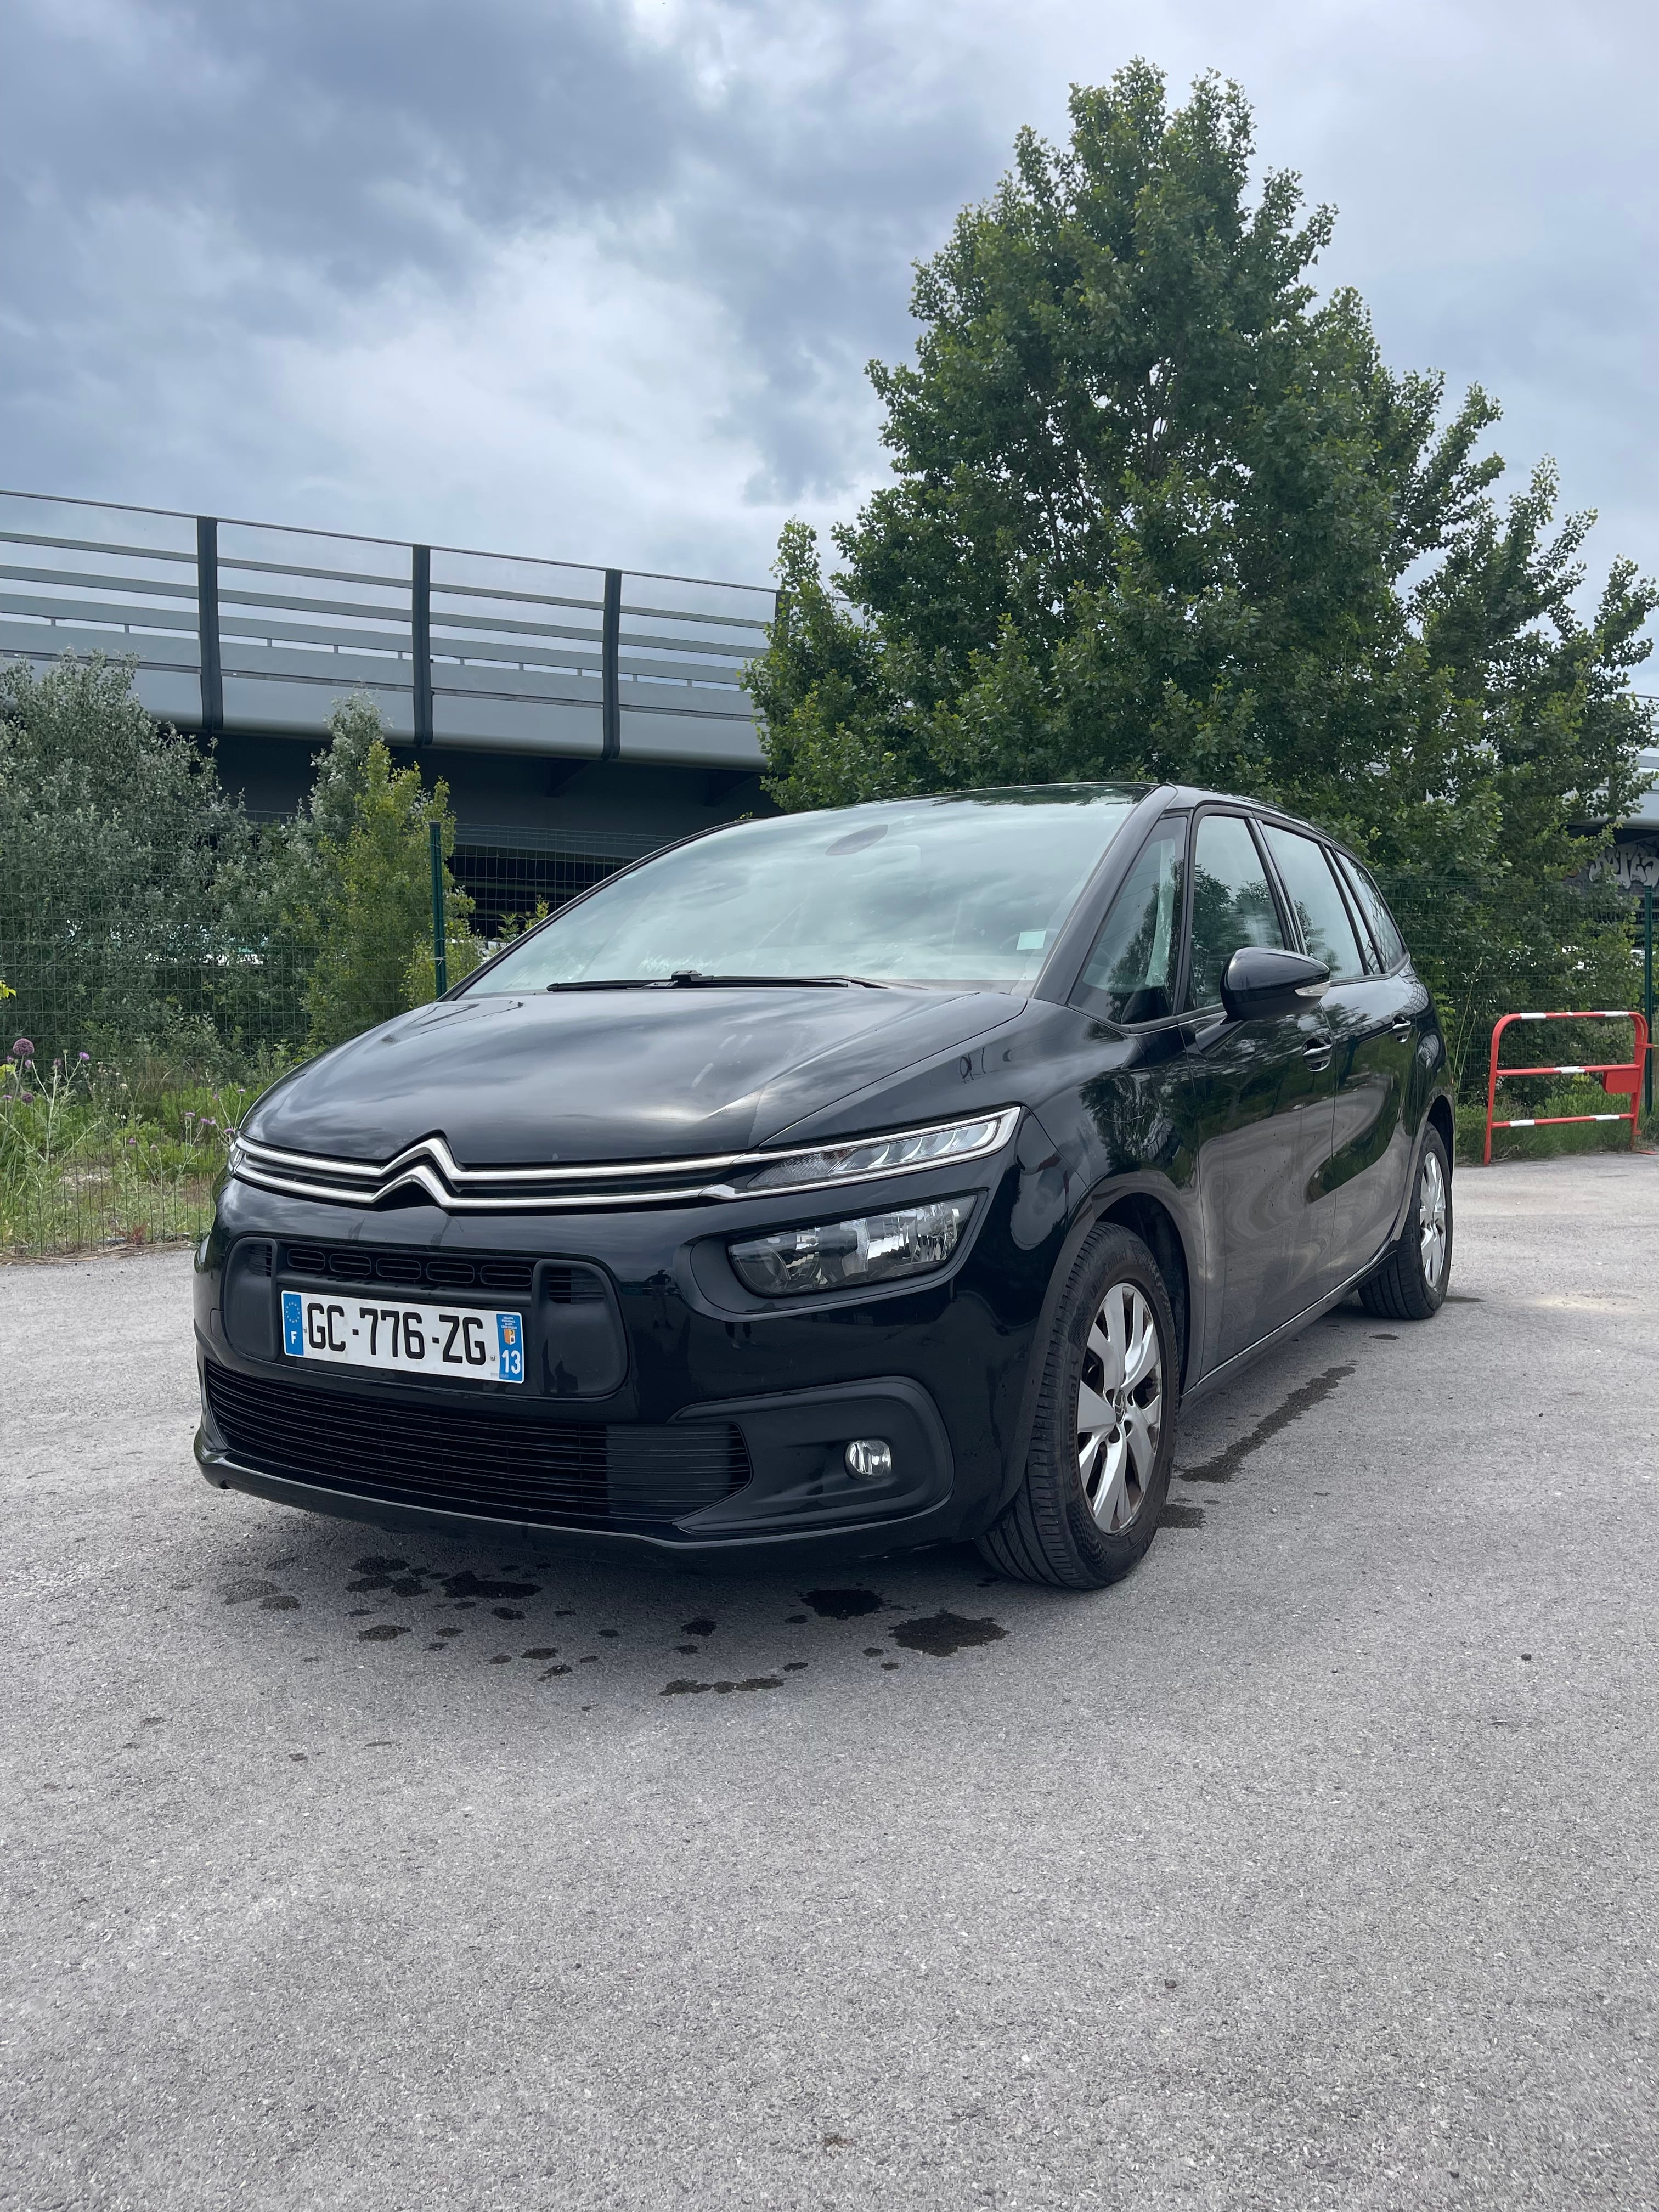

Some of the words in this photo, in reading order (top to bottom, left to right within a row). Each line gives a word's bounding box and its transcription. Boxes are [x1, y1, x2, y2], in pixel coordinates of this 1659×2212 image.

[291, 1331, 296, 1344] F
[307, 1302, 486, 1365] GC-776-ZG
[501, 1349, 521, 1374] 13
[1066, 1374, 1079, 1490] Continental
